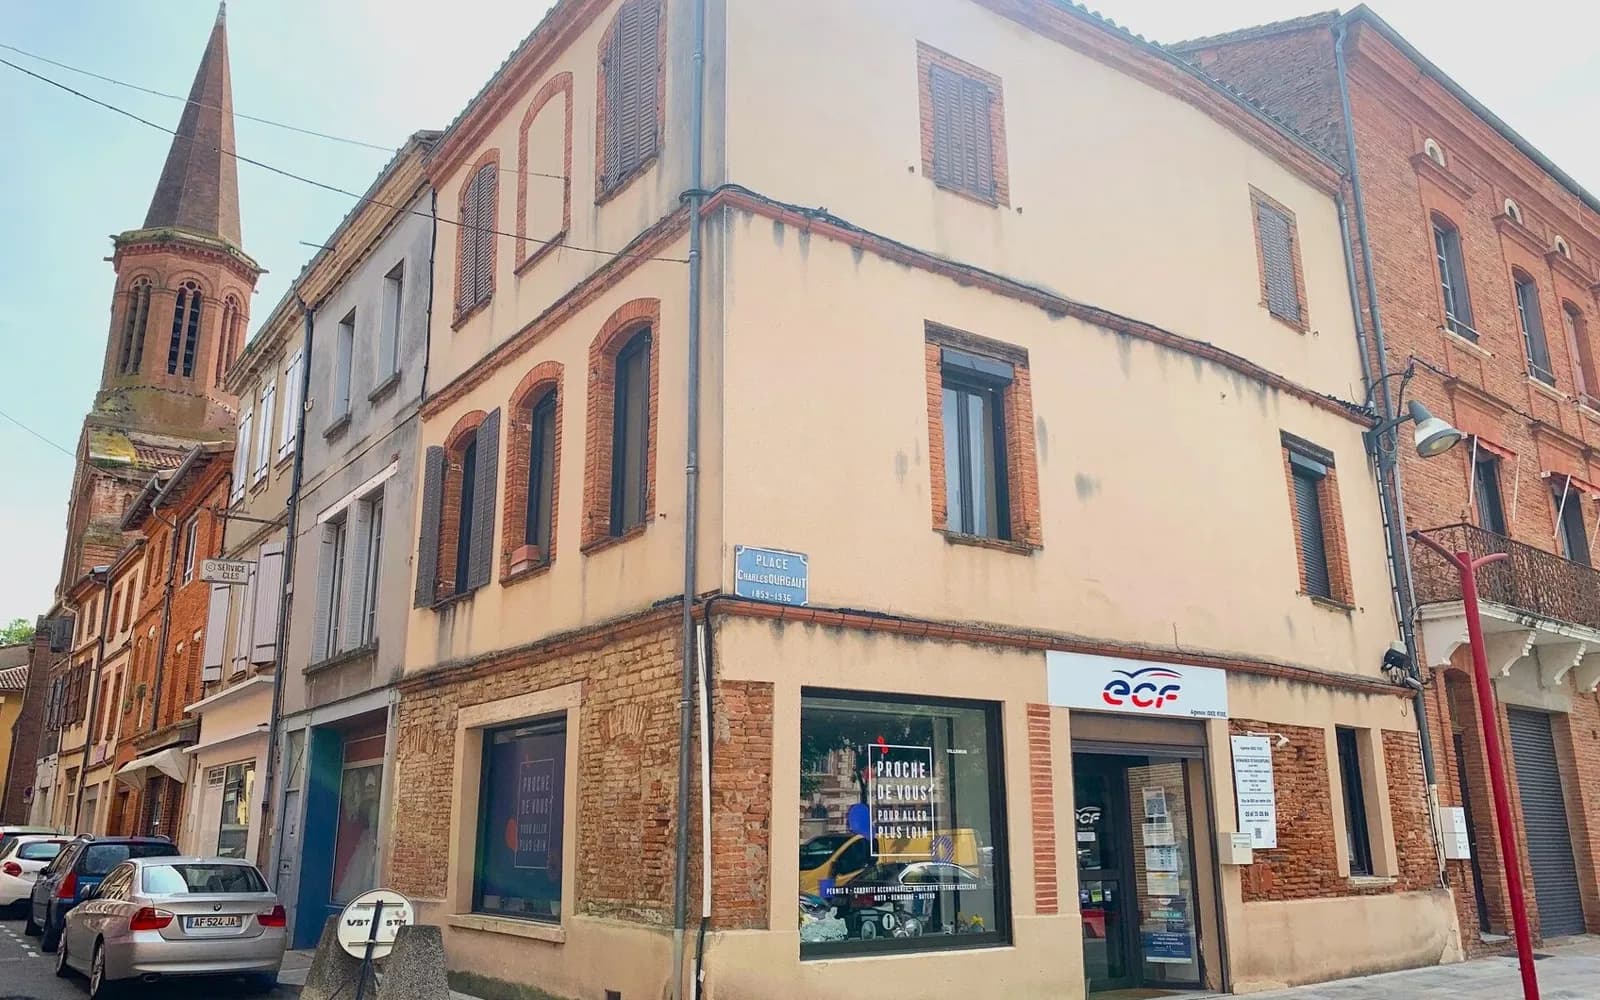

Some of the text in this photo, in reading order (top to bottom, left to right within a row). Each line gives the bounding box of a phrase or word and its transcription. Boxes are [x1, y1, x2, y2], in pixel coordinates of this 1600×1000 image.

[217, 563, 245, 573] SERVICE
[756, 555, 789, 570] PLACE
[768, 574, 806, 589] OURGAUT
[877, 761, 926, 778] PROCHE
[877, 784, 927, 801] DE VOUS
[878, 810, 928, 822] POUR ALLER
[878, 826, 928, 839] PLUS LOIN
